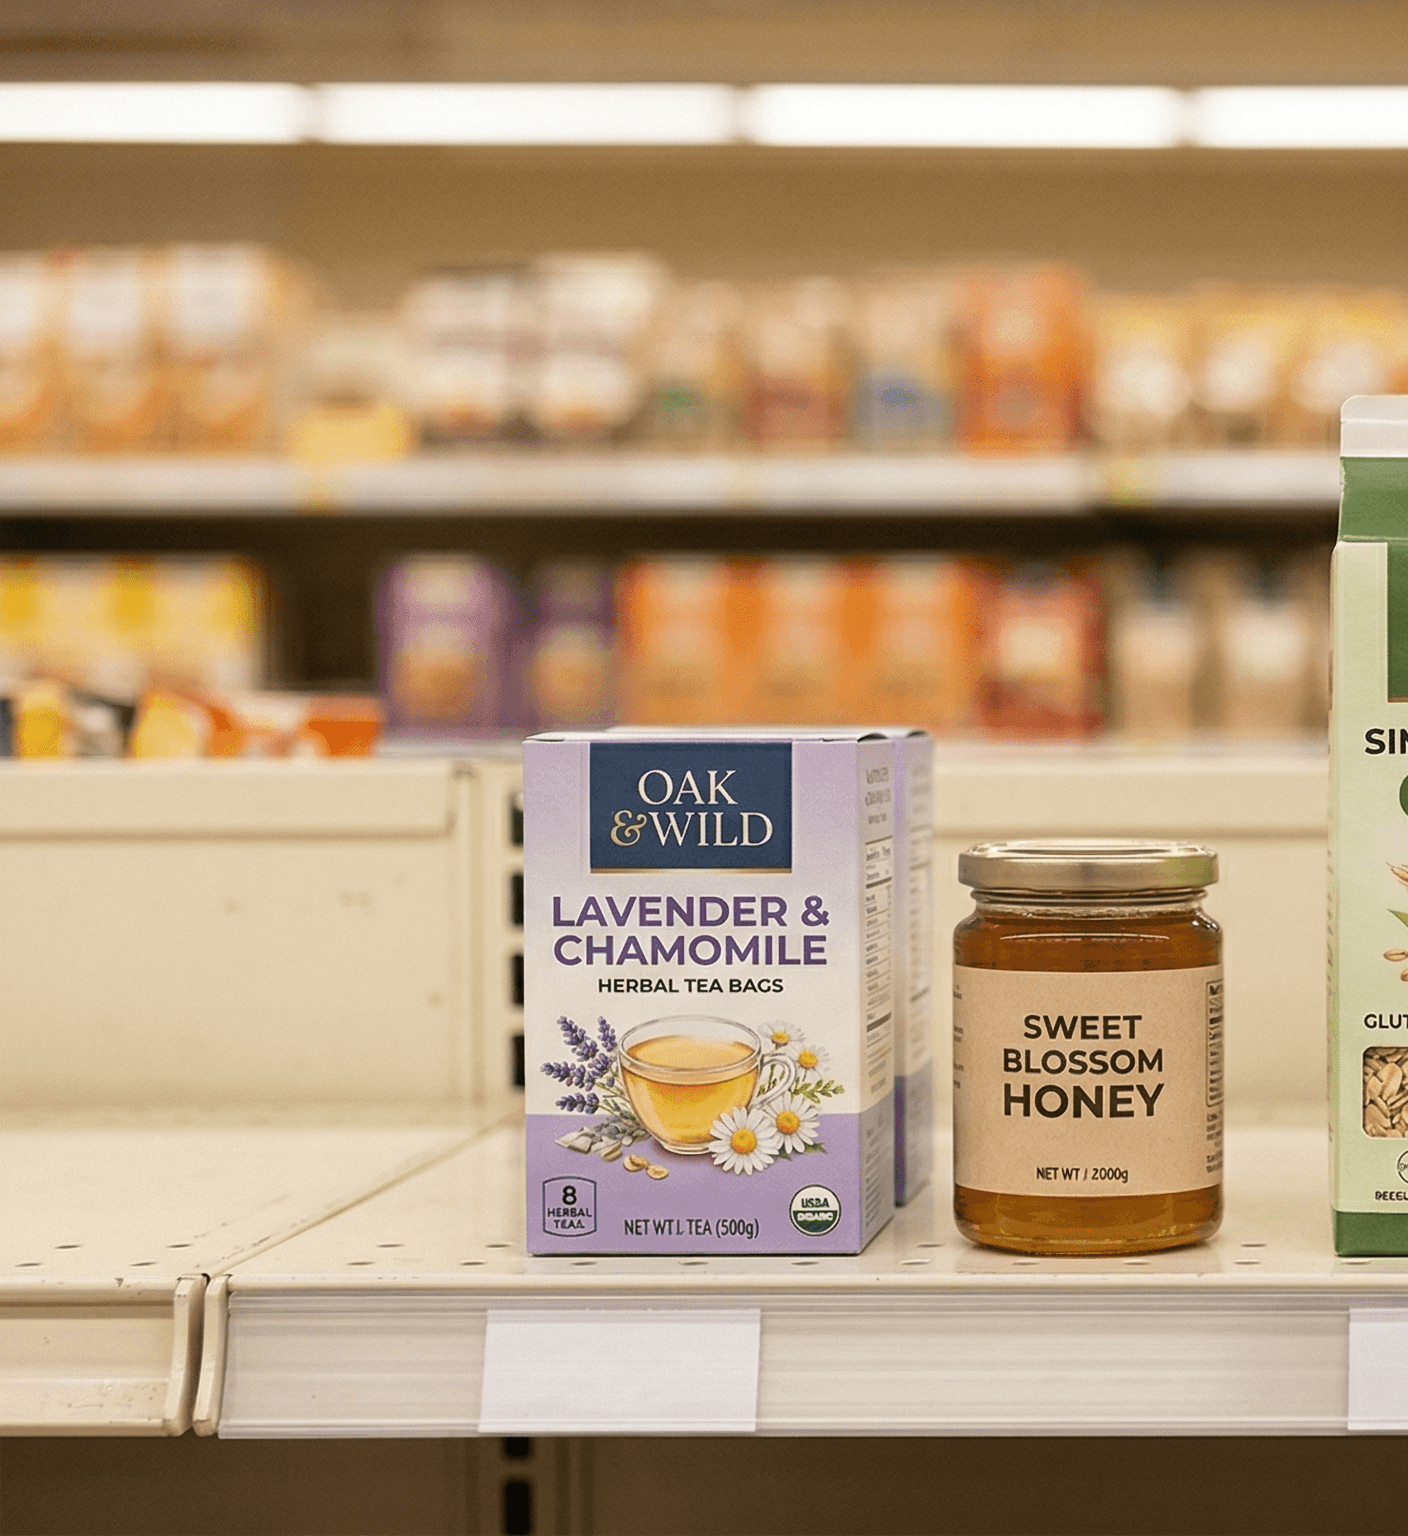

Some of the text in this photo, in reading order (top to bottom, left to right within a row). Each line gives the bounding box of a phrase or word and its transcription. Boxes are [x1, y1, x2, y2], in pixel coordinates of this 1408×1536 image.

[638, 769, 739, 805] OAK
[610, 809, 773, 847] &WILD
[552, 895, 830, 927] LAVENDER &
[553, 934, 828, 966] CHAMOMILE
[598, 978, 784, 994] HERBAL TEA BAGS
[1023, 1014, 1143, 1040] SWEET
[1003, 1048, 1163, 1075] BLOSSOM
[1003, 1082, 1165, 1119] HONEY
[1036, 1166, 1060, 1181] NET
[1061, 1167, 1081, 1181] WT
[1091, 1167, 1129, 1184] 2000g
[561, 1185, 578, 1206] 8
[547, 1207, 593, 1218] HERBAL
[624, 1219, 651, 1236] NET
[652, 1218, 675, 1236] WT
[685, 1218, 713, 1236] TEA
[715, 1217, 760, 1240] (500g)
